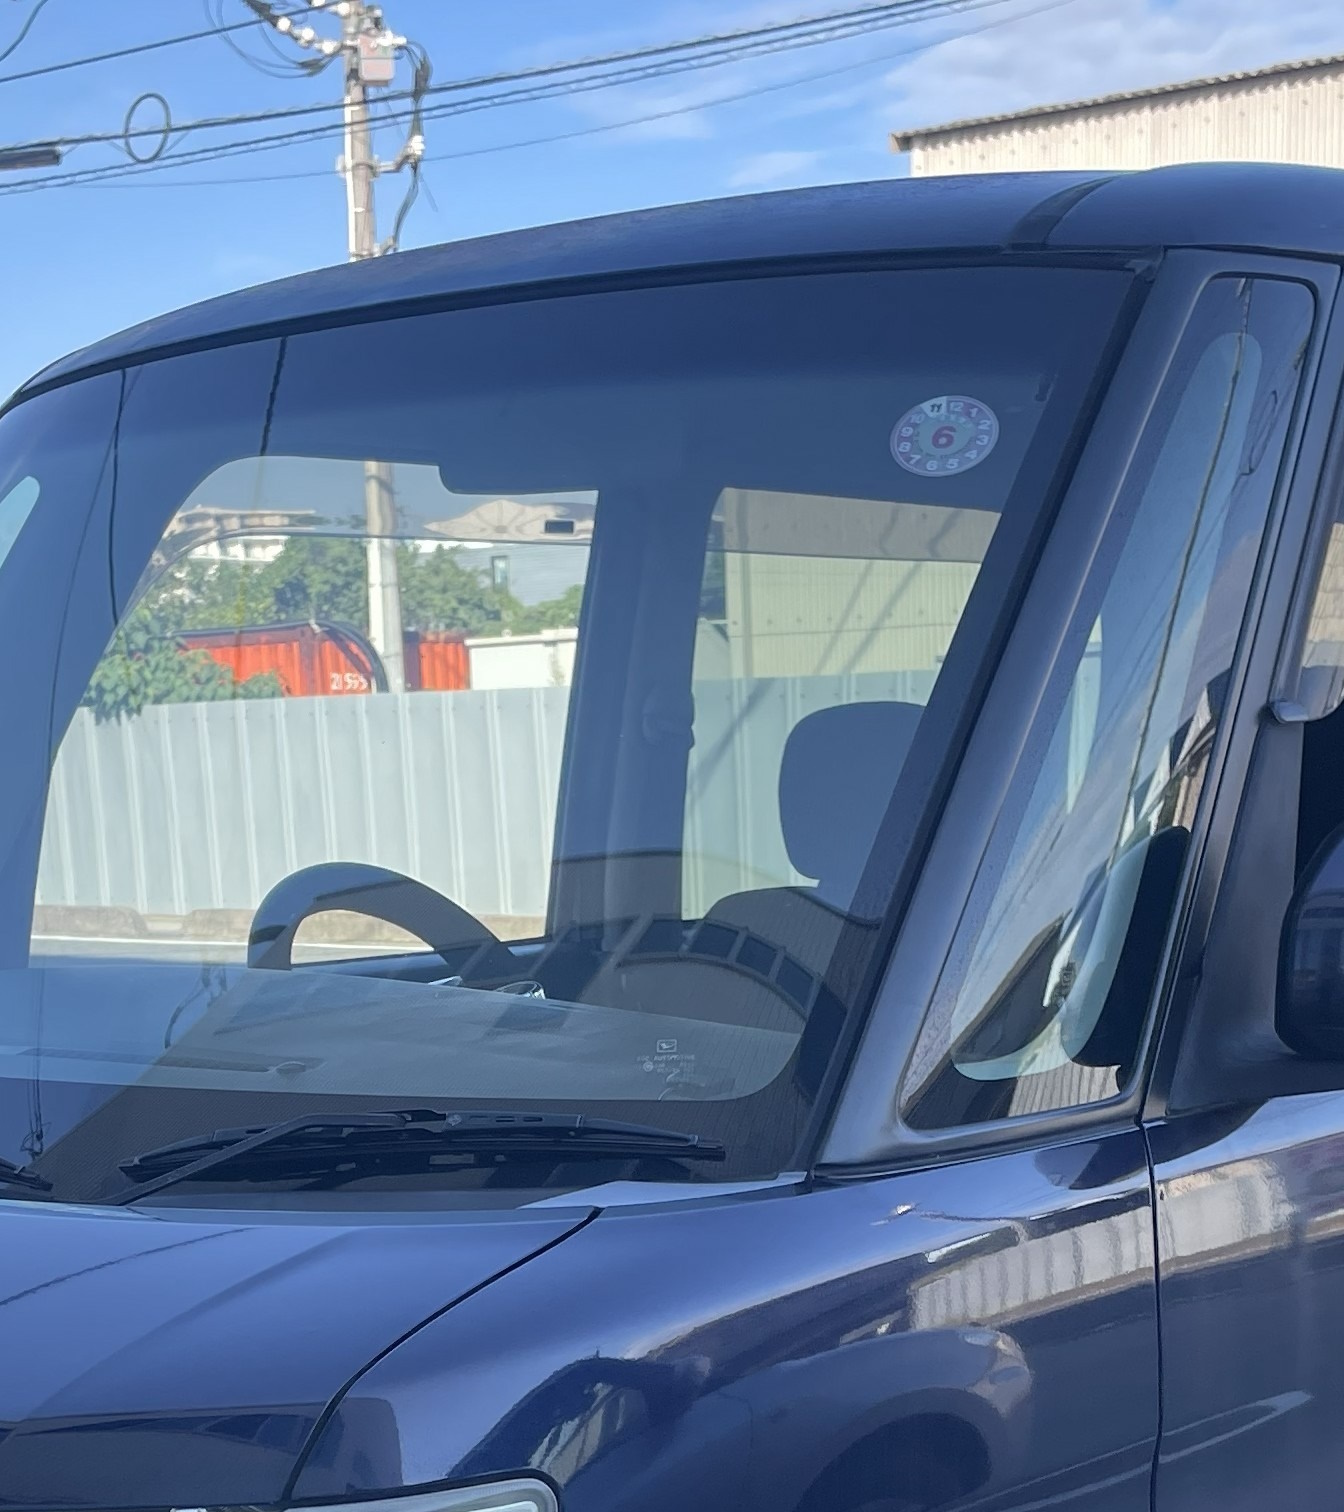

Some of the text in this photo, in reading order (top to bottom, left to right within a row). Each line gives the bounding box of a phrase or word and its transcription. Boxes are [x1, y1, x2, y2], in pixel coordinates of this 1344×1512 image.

[978, 420, 991, 430] 2
[901, 427, 913, 437] 9
[932, 426, 956, 448] 6
[976, 435, 989, 445] 3
[899, 442, 911, 452] 8
[909, 455, 921, 464] 7
[964, 450, 977, 459] 4
[926, 461, 937, 470] 6
[946, 459, 959, 468] 5
